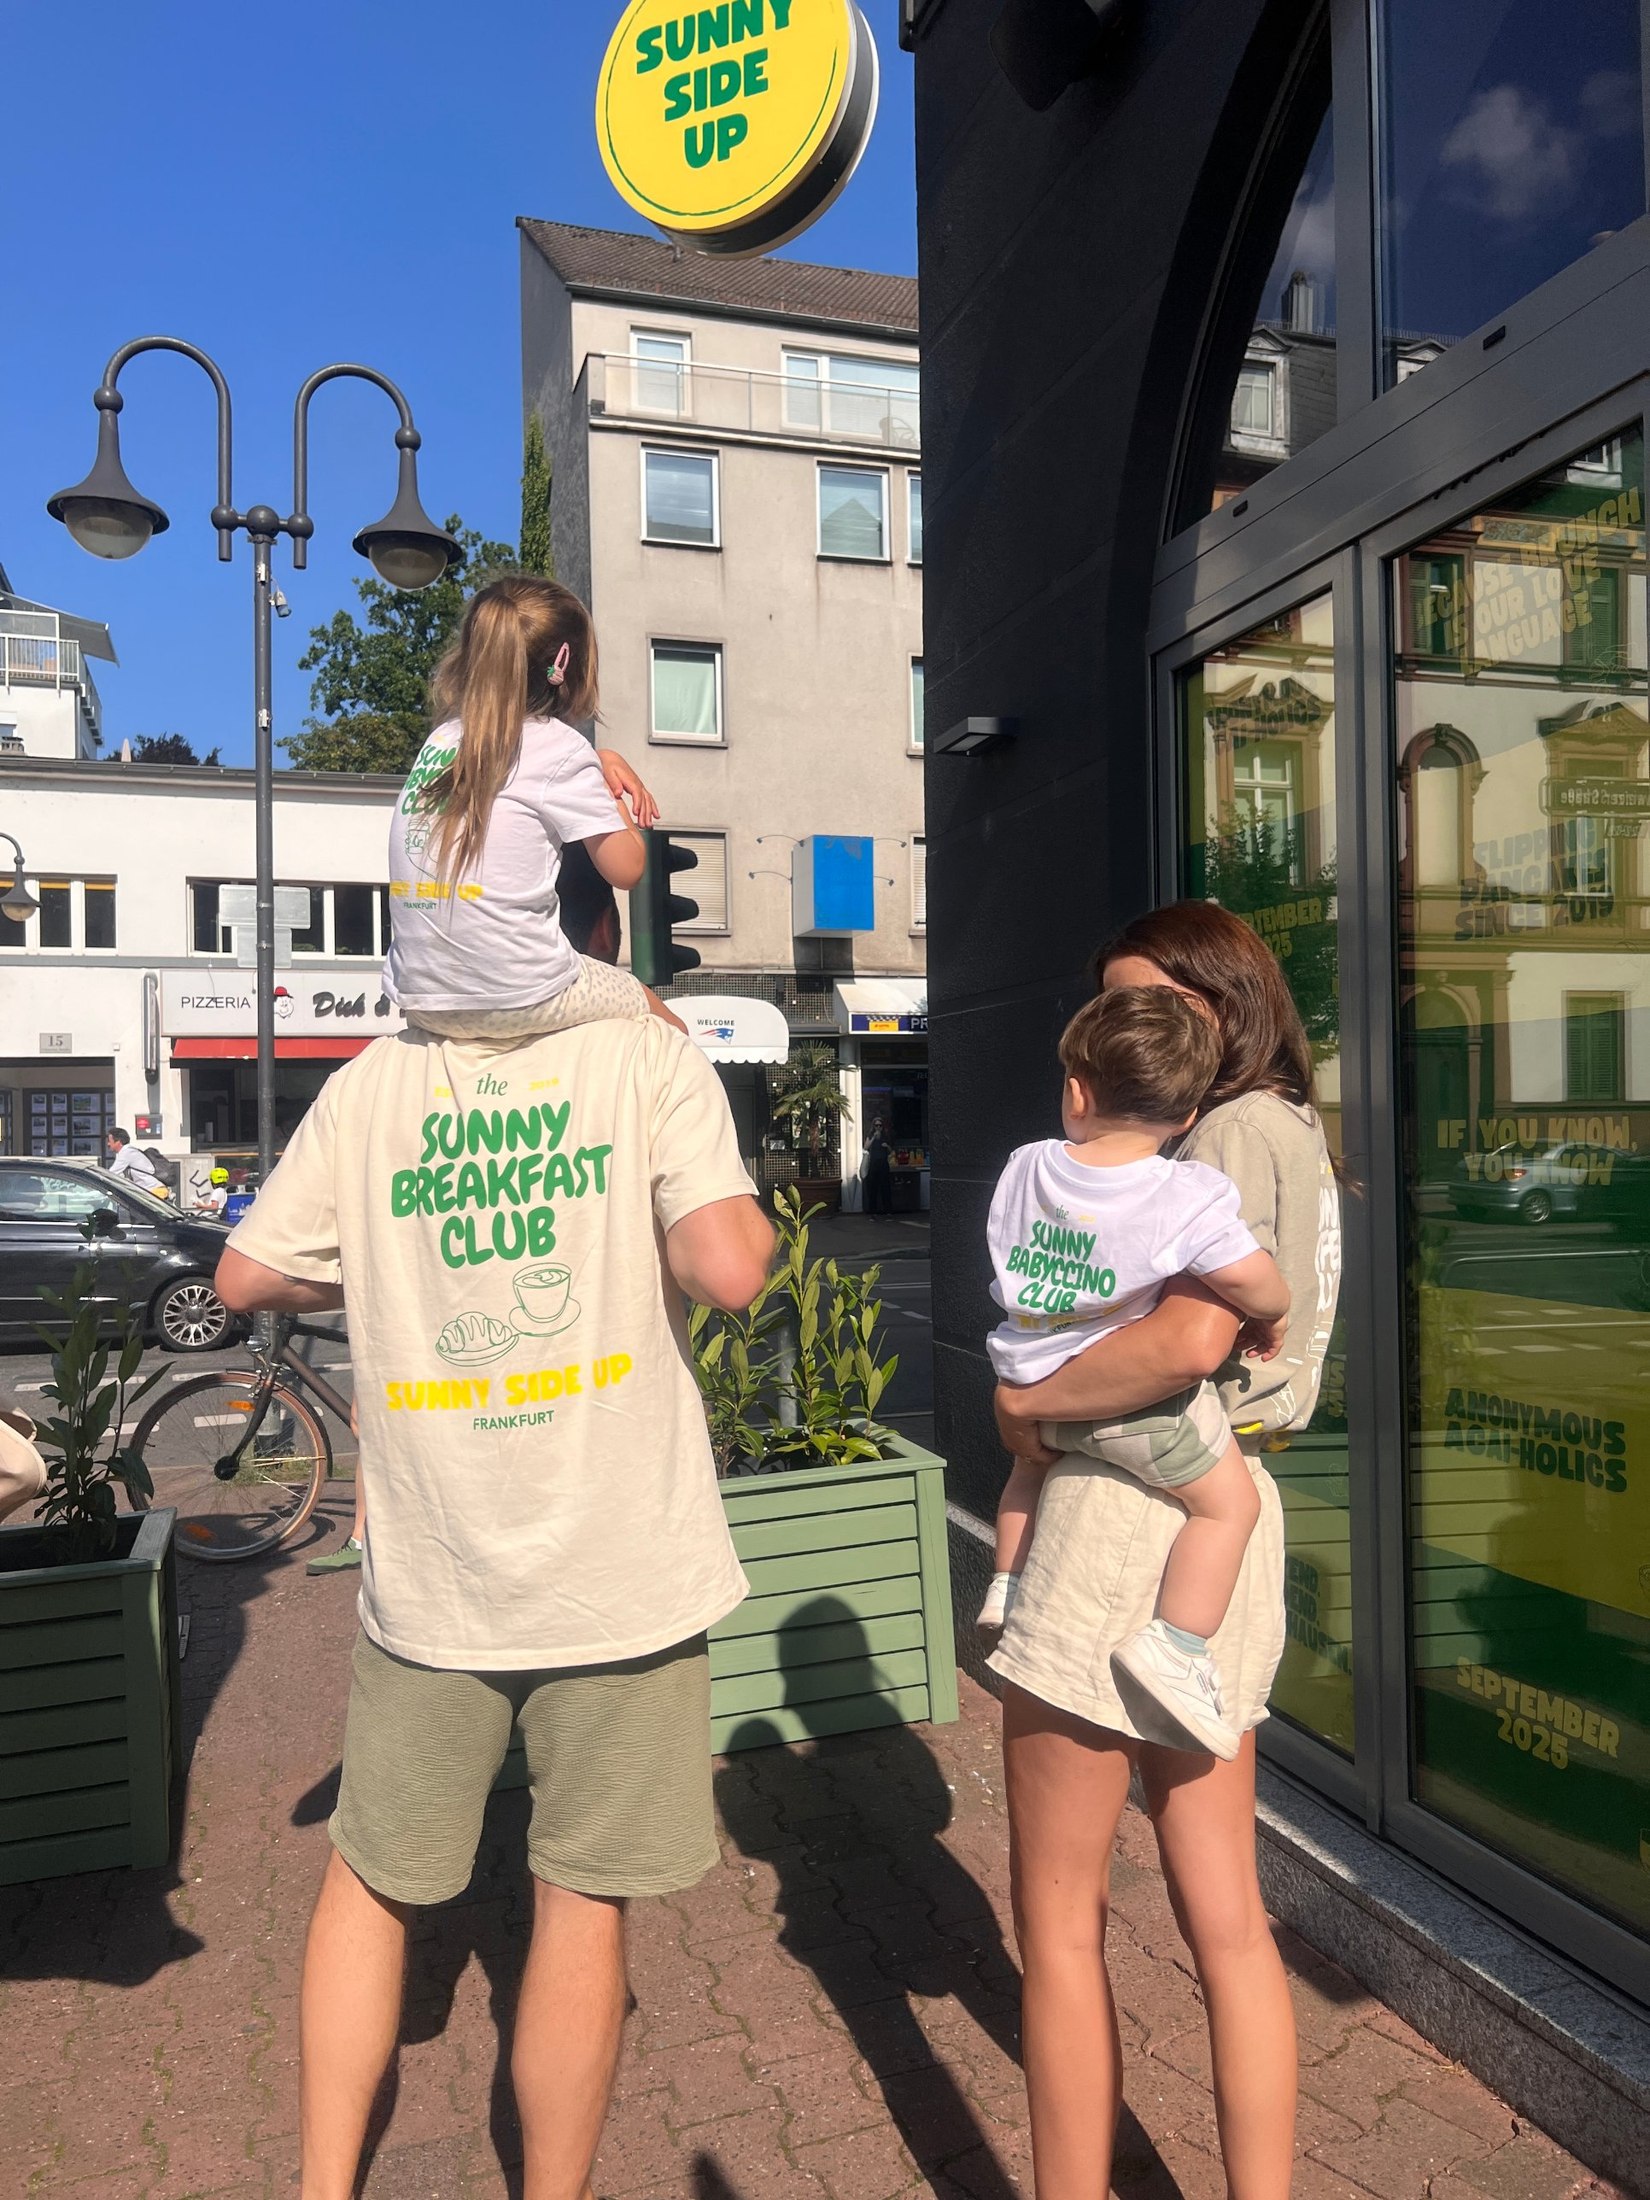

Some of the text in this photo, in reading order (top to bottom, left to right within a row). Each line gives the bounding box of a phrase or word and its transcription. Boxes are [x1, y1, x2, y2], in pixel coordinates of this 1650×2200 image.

[636, 0, 792, 74] SUNNY
[664, 47, 768, 122] SIDE
[684, 113, 748, 169] UP
[1477, 586, 1525, 634] OUR
[1531, 547, 1600, 610] LOVE
[1460, 590, 1592, 676] LANGUAGE
[1474, 818, 1597, 870] FLIPPING
[1460, 848, 1606, 907] PANCAKES
[403, 902, 437, 910] FRANKFURT
[1235, 897, 1323, 934] PTEMBER
[1454, 898, 1547, 941] SINCE
[181, 996, 251, 1009] PIZZERIA
[313, 991, 366, 1018] Dick
[697, 1019, 735, 1027] WELCOME
[48, 1035, 64, 1048] 15
[476, 1073, 508, 1096] the
[421, 1100, 571, 1164] SUNNY
[1437, 1119, 1466, 1149] IF
[1479, 1118, 1538, 1149] YOU
[391, 1144, 613, 1218] BREAKFAST
[1463, 1152, 1615, 1186] YOU KNOW
[440, 1206, 556, 1269] CLUB
[1056, 1205, 1069, 1220] the
[1029, 1220, 1097, 1262] SUNNY
[1006, 1245, 1116, 1298] BABYCCINO
[1018, 1282, 1077, 1313] CLUB
[385, 1352, 633, 1412] SUNNY SIDE UP
[472, 1410, 555, 1431] FRANKFURT
[1444, 1388, 1627, 1456] ANONYMOUS
[1456, 1656, 1620, 1759] SEPTEMBER
[1496, 1708, 1568, 1769] 2025
